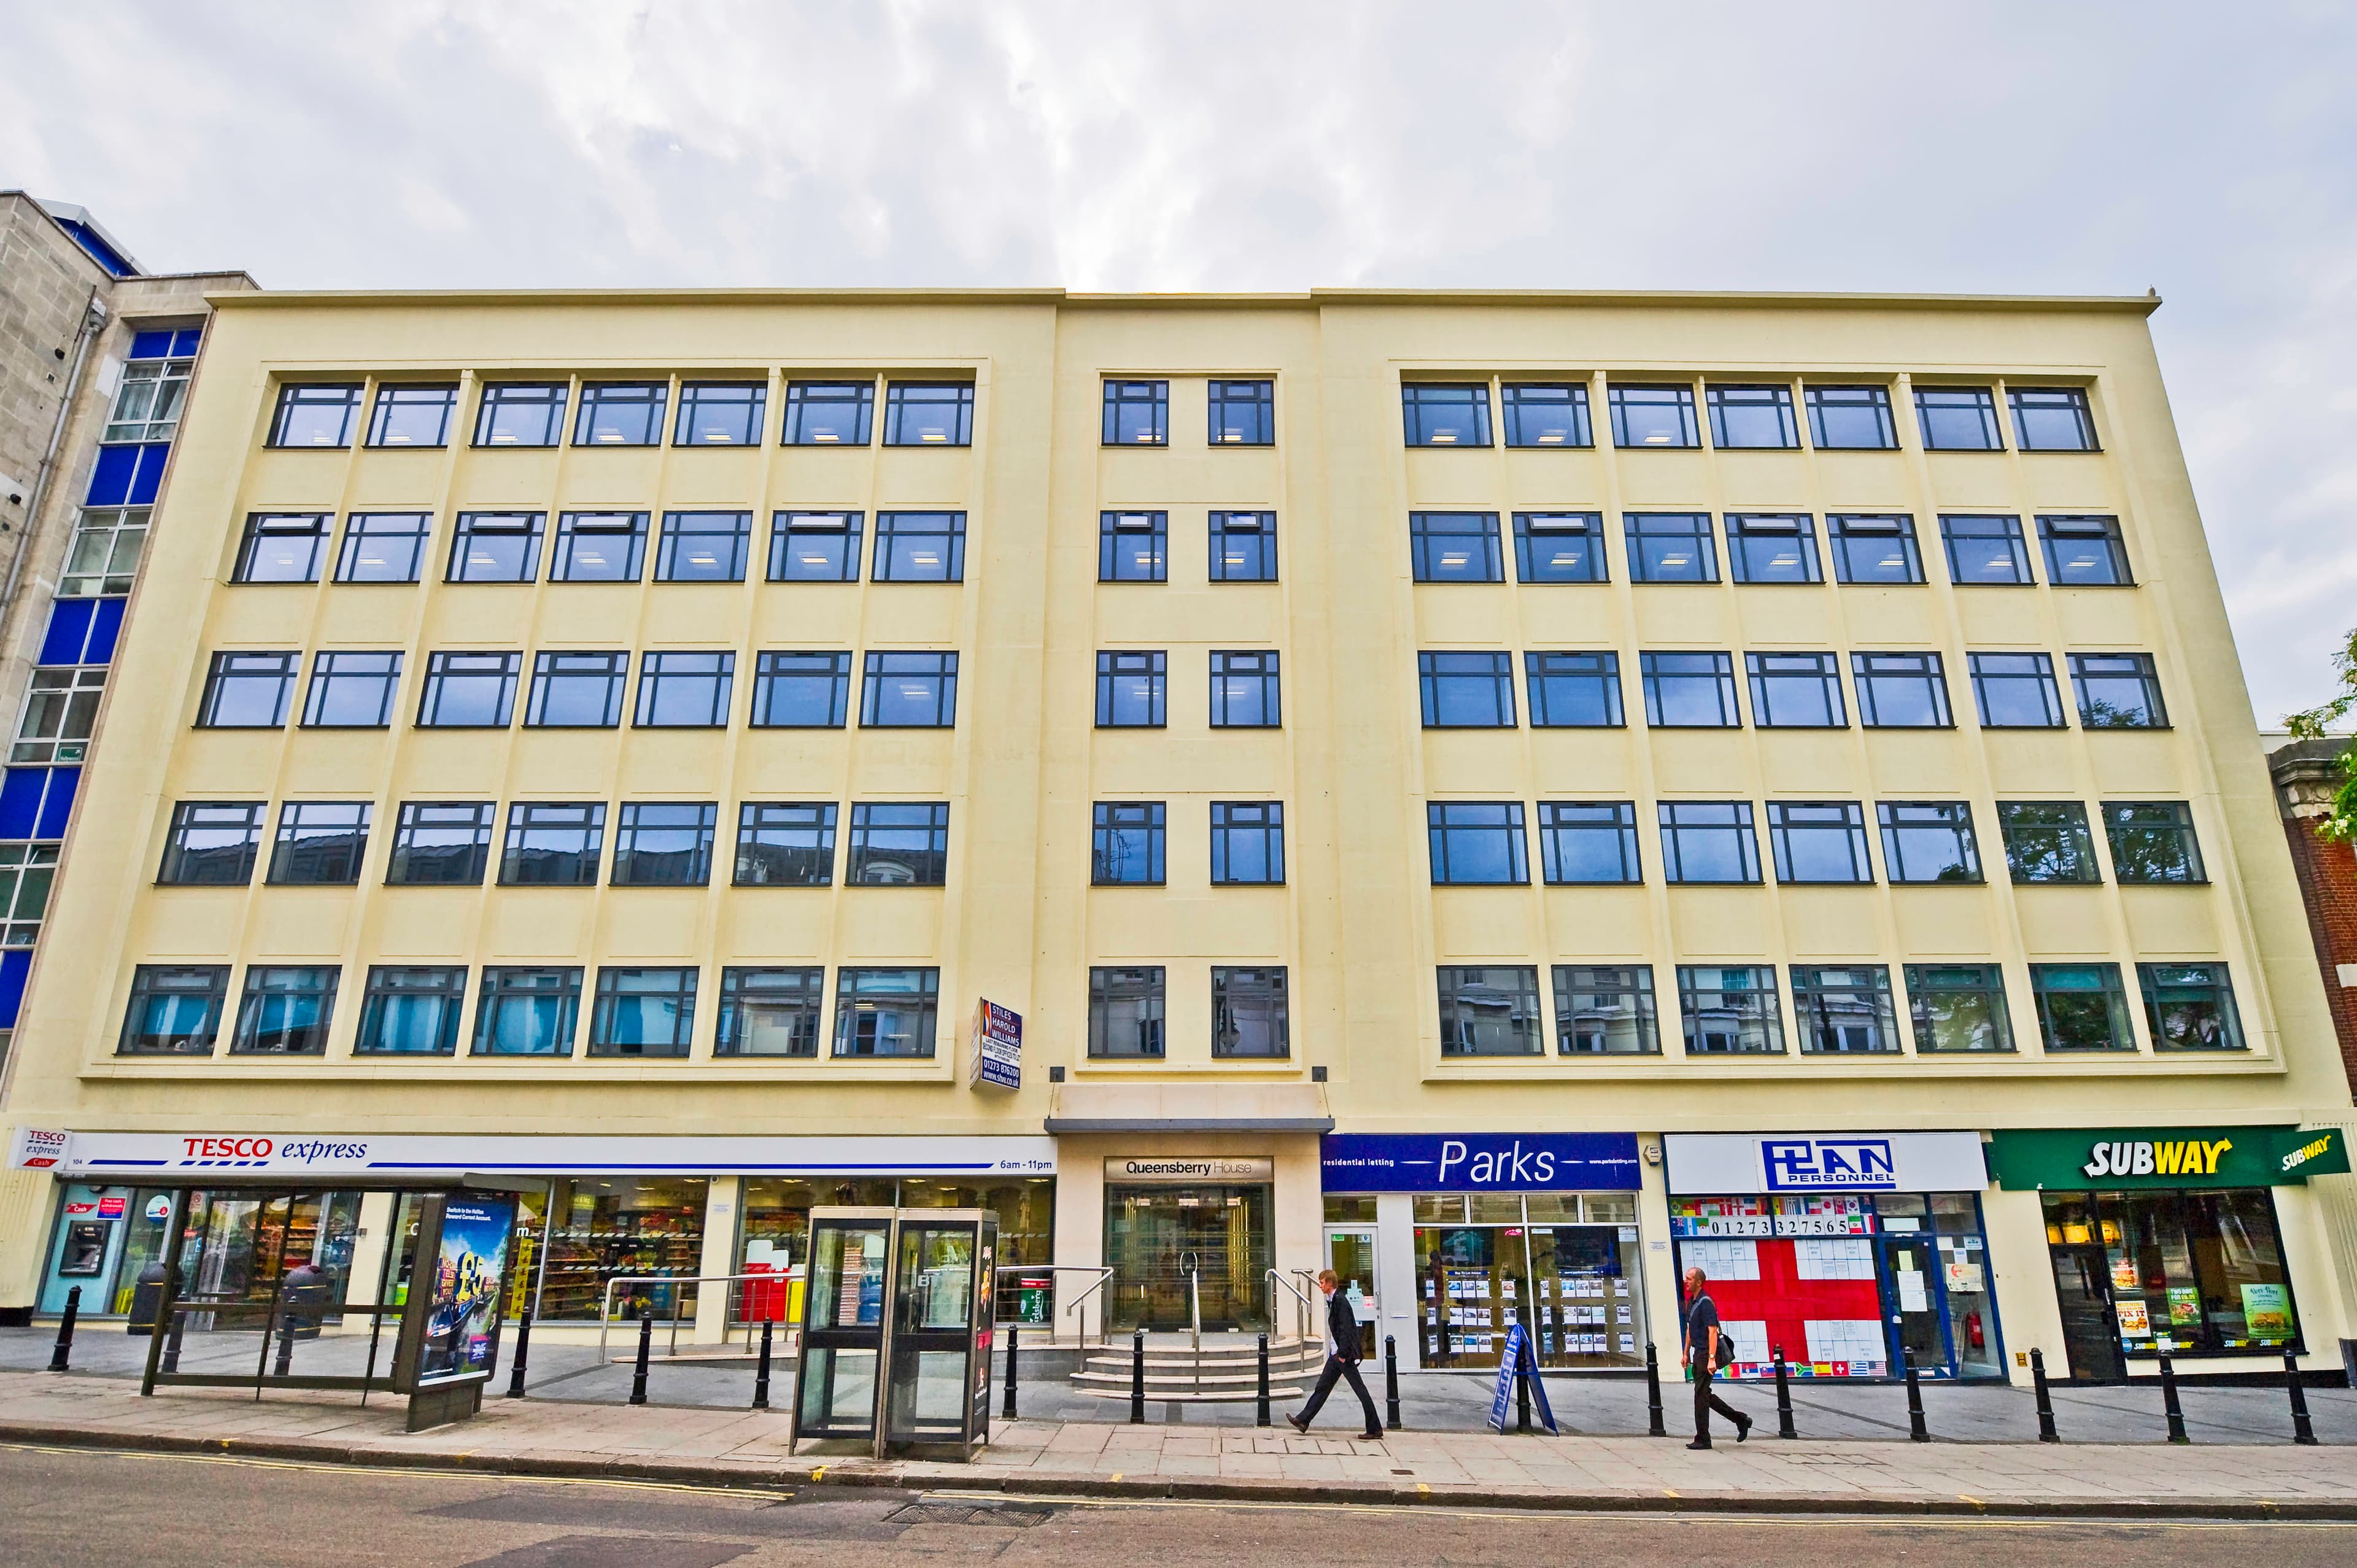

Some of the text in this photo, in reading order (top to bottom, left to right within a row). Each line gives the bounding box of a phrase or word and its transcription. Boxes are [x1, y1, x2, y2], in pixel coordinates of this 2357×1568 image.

[993, 1005, 1012, 1020] STILES
[992, 1017, 1015, 1033] HAROLD
[992, 1029, 1020, 1046] WILLIAMS
[984, 1059, 1019, 1078] 01273 876200
[983, 1070, 1019, 1087] www.shw.co.uk
[29, 1130, 66, 1141] TESCO
[26, 1145, 61, 1155] express
[184, 1138, 367, 1164] TESCO express
[2084, 1137, 2233, 1178] SUBWAY
[2282, 1134, 2331, 1171] SUBWAY
[1000, 1160, 1021, 1169] 6am
[1028, 1160, 1052, 1172] 11pm
[1126, 1161, 1252, 1175] Queensberry House
[1368, 1159, 1394, 1167] letting
[1439, 1140, 1555, 1183] Parks
[1762, 1140, 1895, 1190] PLAN
[1789, 1173, 1895, 1182] PERSONNEL
